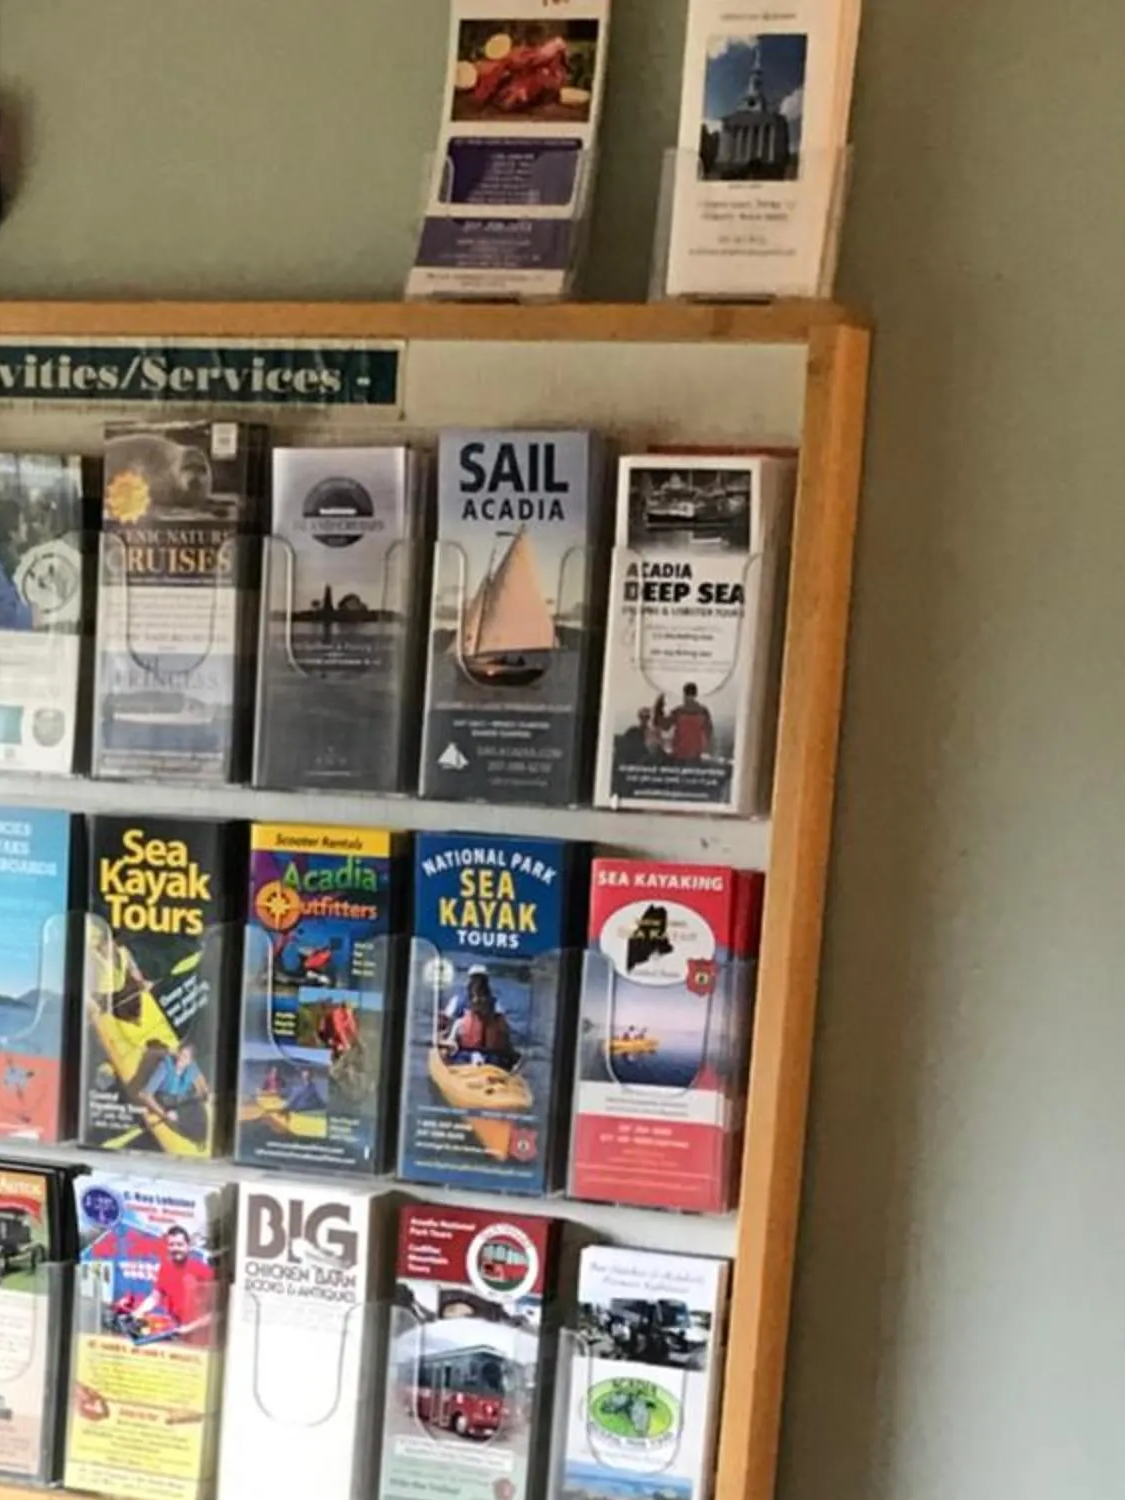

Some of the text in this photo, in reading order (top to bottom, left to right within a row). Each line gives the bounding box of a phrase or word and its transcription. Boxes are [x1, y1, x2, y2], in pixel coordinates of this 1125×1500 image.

[458, 442, 570, 494] SAIL
[460, 497, 566, 522] ACADIA
[106, 546, 233, 574] CRUISES
[626, 561, 693, 580] ACADIA
[623, 580, 745, 605] DEEP SEA
[122, 828, 188, 867] Sea
[99, 857, 211, 906] Kayak
[282, 855, 379, 892] Acadia
[421, 847, 558, 886] NATIONAL PARK
[459, 868, 516, 900] SEA
[597, 870, 725, 892] SEA KAYAKING
[104, 894, 204, 935] Tours
[438, 897, 539, 933] KAYAK
[456, 930, 520, 950] TOURS
[246, 1193, 358, 1271] BIG
